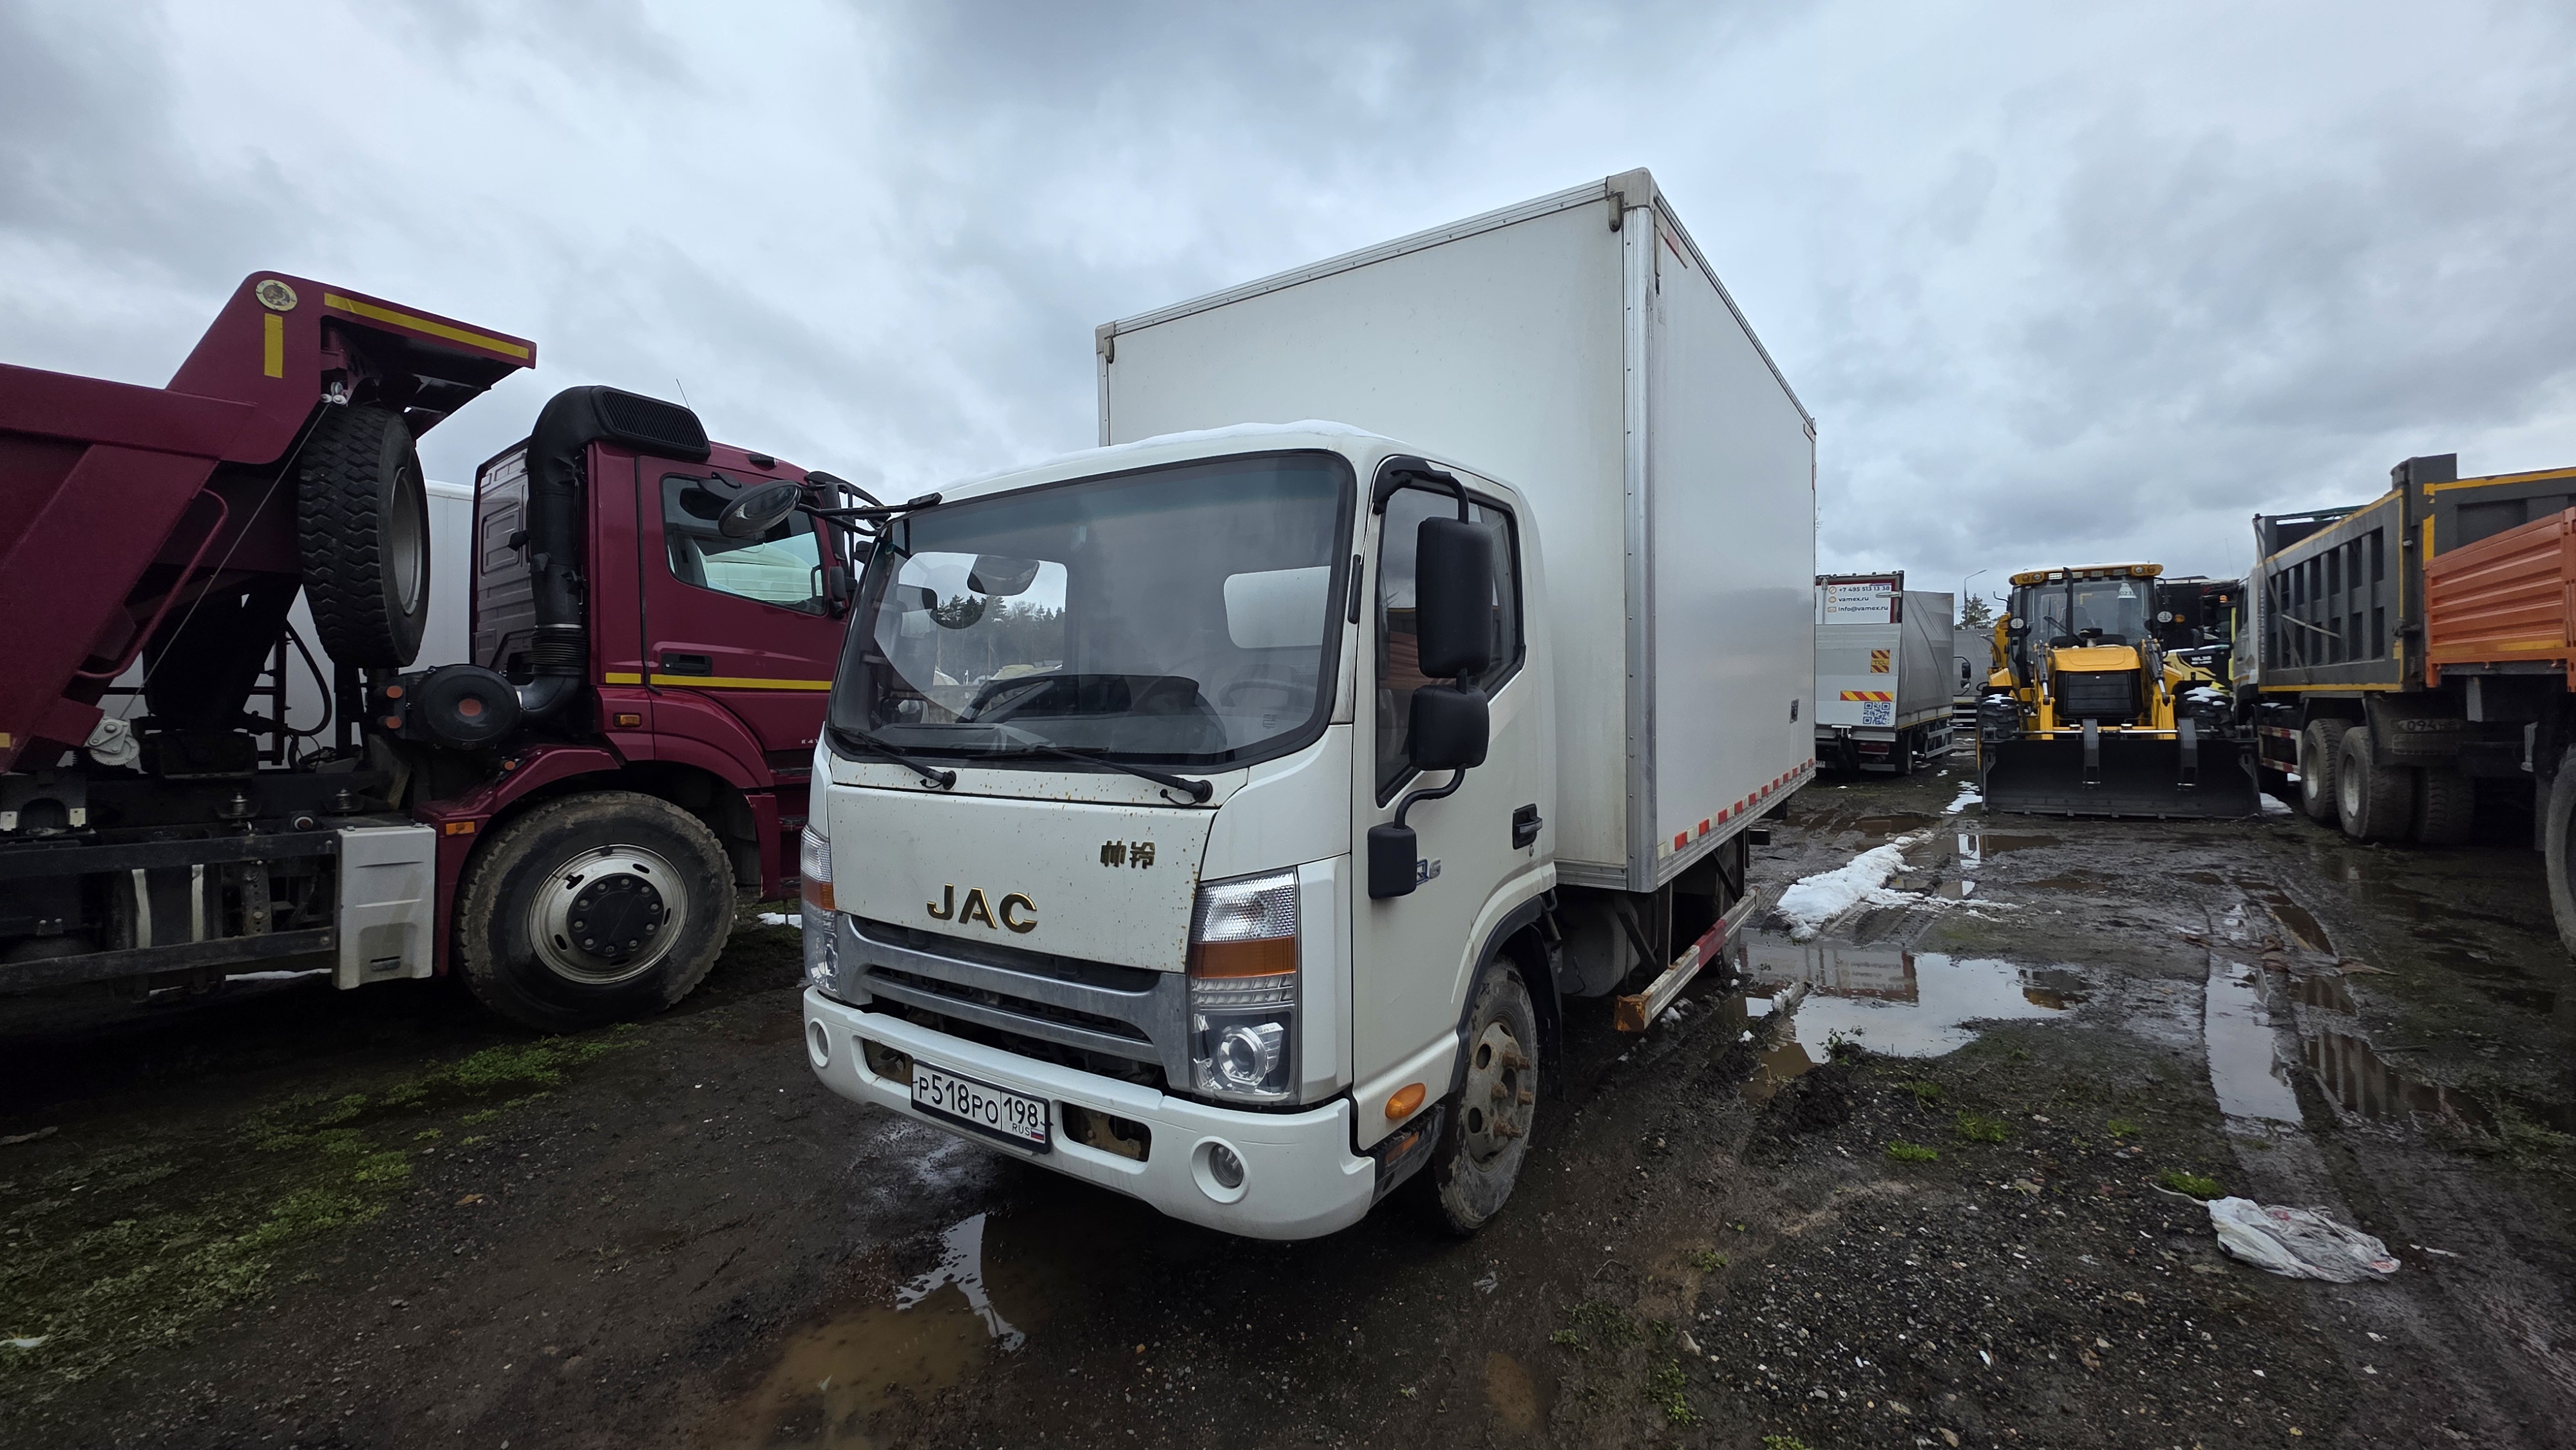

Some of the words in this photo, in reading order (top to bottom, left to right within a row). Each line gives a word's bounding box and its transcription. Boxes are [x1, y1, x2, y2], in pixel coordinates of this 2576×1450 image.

[927, 883, 1038, 934] JAC
[1003, 1097, 1038, 1127] 198
[1012, 1123, 1030, 1136] RUS
